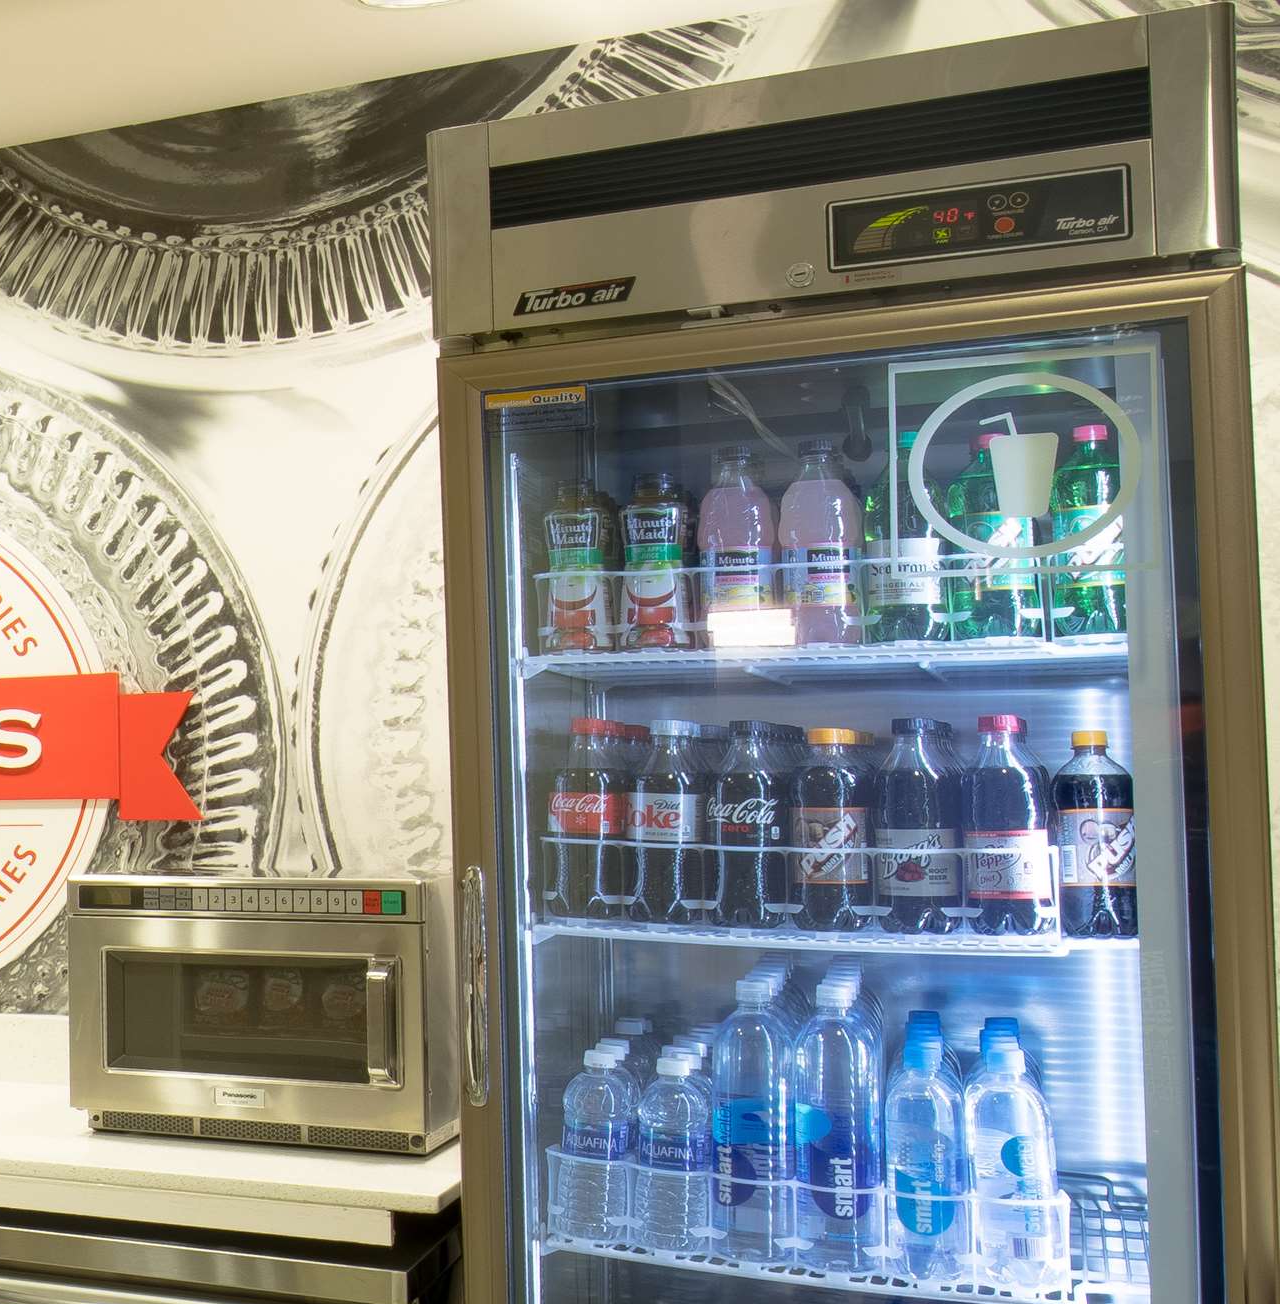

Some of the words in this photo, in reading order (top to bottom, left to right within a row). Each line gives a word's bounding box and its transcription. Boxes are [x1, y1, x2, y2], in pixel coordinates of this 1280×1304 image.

[1057, 215, 1095, 231] Turbo
[1098, 214, 1120, 226] air
[524, 289, 585, 312] Turbo
[592, 284, 625, 303] air
[533, 392, 581, 405] Quality
[628, 516, 674, 532] Minute
[631, 528, 667, 543] Maid
[551, 793, 607, 814] Coca-Cola
[706, 796, 779, 826] Coca-Cola
[566, 1131, 618, 1153] AQUAFINA
[641, 1139, 694, 1161] AQUAFINA
[718, 1145, 734, 1206] smart
[835, 1157, 854, 1218] smart
[916, 1180, 932, 1234] smart
